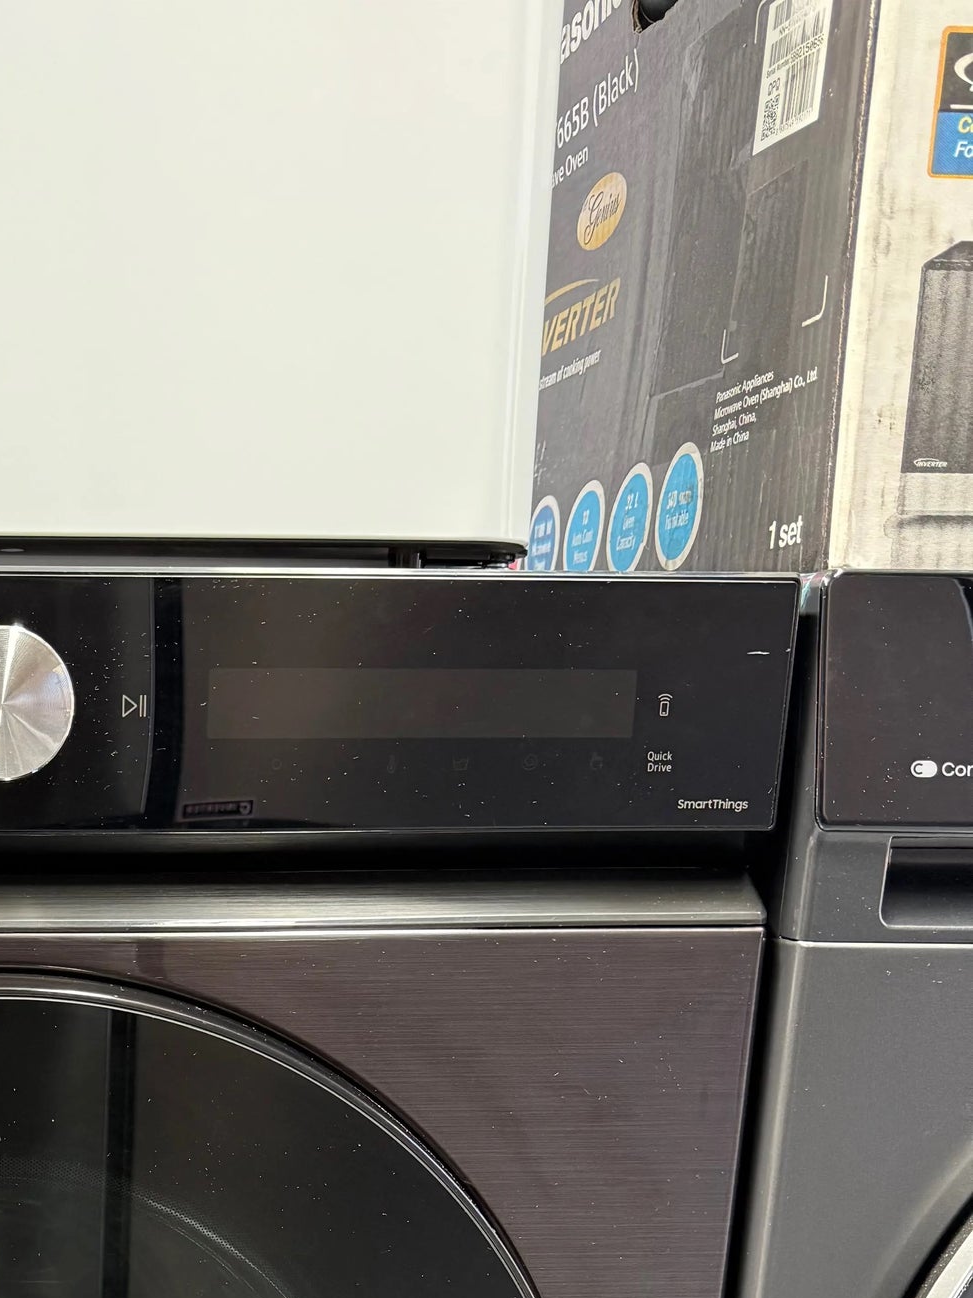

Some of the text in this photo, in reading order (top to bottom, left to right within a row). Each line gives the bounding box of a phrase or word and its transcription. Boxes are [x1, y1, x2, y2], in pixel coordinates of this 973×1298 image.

[560, 0, 622, 64] ason
[557, 48, 639, 149] 665B (Black)
[565, 146, 589, 178] Oven
[584, 191, 620, 245] Genius
[713, 400, 743, 420] Microwave
[742, 394, 760, 408] Oven
[759, 377, 793, 404] (Shanghai)
[715, 371, 775, 404] Panasonic Appliances
[738, 411, 757, 427] China,
[710, 437, 726, 453] Made
[732, 430, 750, 445] China
[769, 515, 803, 549] 1 set
[647, 751, 673, 762] Quick
[647, 763, 672, 772] Drive
[677, 799, 749, 812] SmartThings
